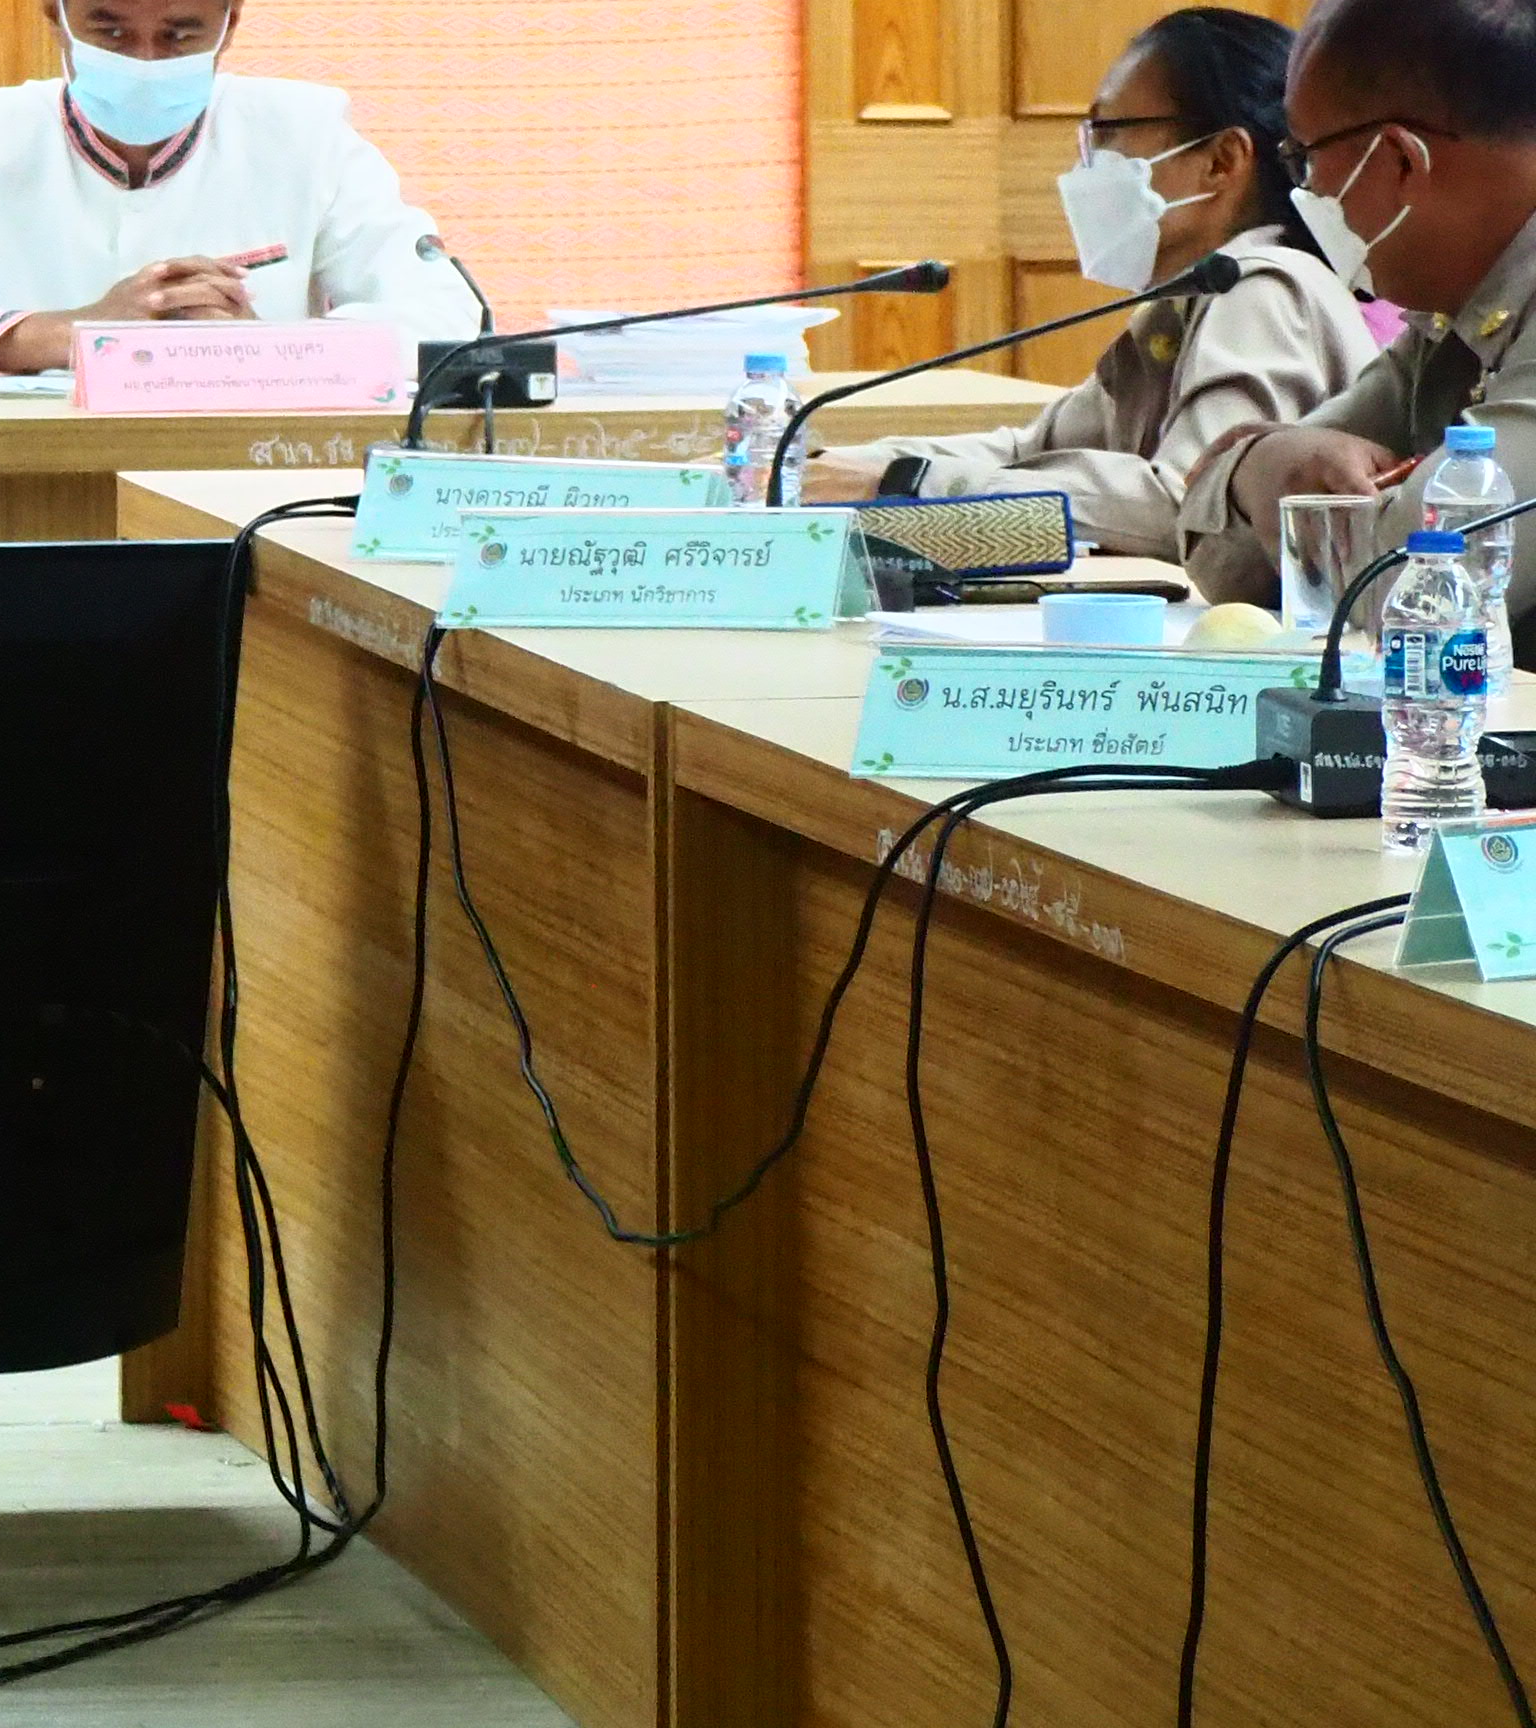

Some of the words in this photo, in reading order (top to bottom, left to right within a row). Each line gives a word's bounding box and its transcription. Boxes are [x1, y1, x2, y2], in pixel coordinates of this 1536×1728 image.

[519, 539, 648, 577] นายณัฐวุฒิ
[664, 537, 775, 568] ศรีวิจารย์
[559, 585, 624, 605] ประเภท
[630, 584, 717, 605] นักวิชาการ
[941, 678, 1121, 721] น.ส.มยุรินทร์
[1136, 679, 1248, 715] พันสนิท
[1007, 731, 1084, 755] ประเภท
